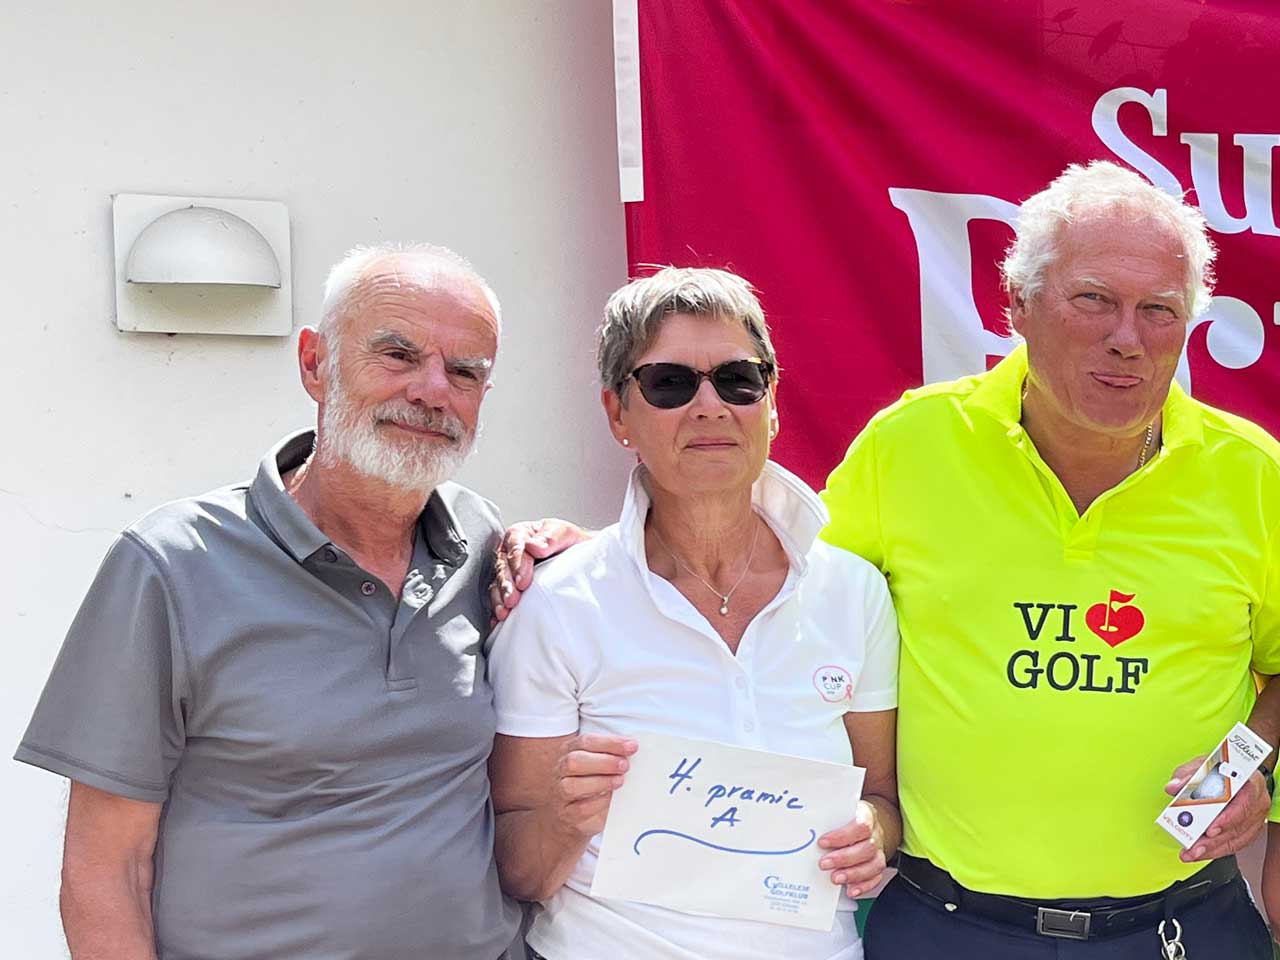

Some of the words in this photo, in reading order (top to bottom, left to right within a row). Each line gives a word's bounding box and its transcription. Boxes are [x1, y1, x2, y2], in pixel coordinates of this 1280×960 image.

[1013, 602, 1078, 642] VI
[822, 675, 845, 683] PNK
[1007, 650, 1149, 694] GOLF
[669, 757, 702, 795] 4.
[710, 806, 741, 828] A
